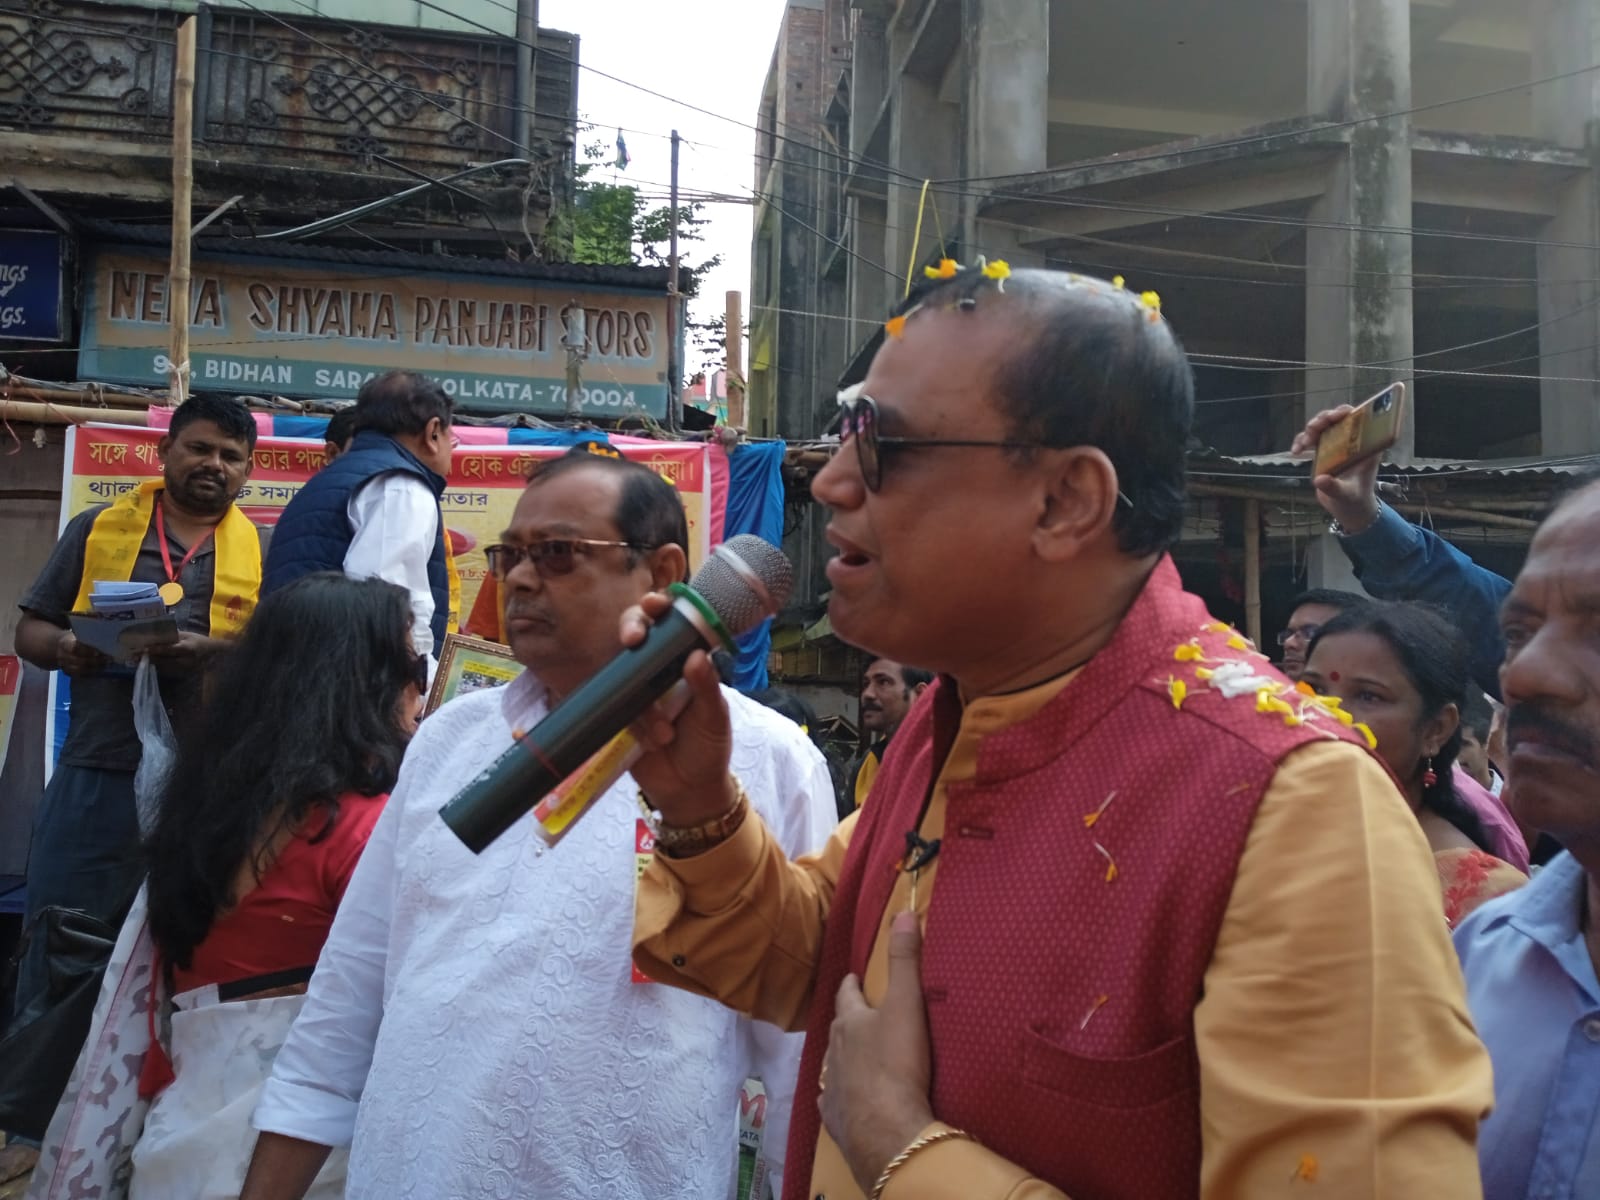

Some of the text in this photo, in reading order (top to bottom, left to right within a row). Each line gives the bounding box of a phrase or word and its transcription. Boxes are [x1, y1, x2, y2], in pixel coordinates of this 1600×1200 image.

[108, 270, 224, 328] NEA
[414, 295, 548, 352] PANJABI
[204, 359, 293, 384] BIDHAN
[314, 368, 383, 391] SAR
[461, 454, 503, 479] হোক
